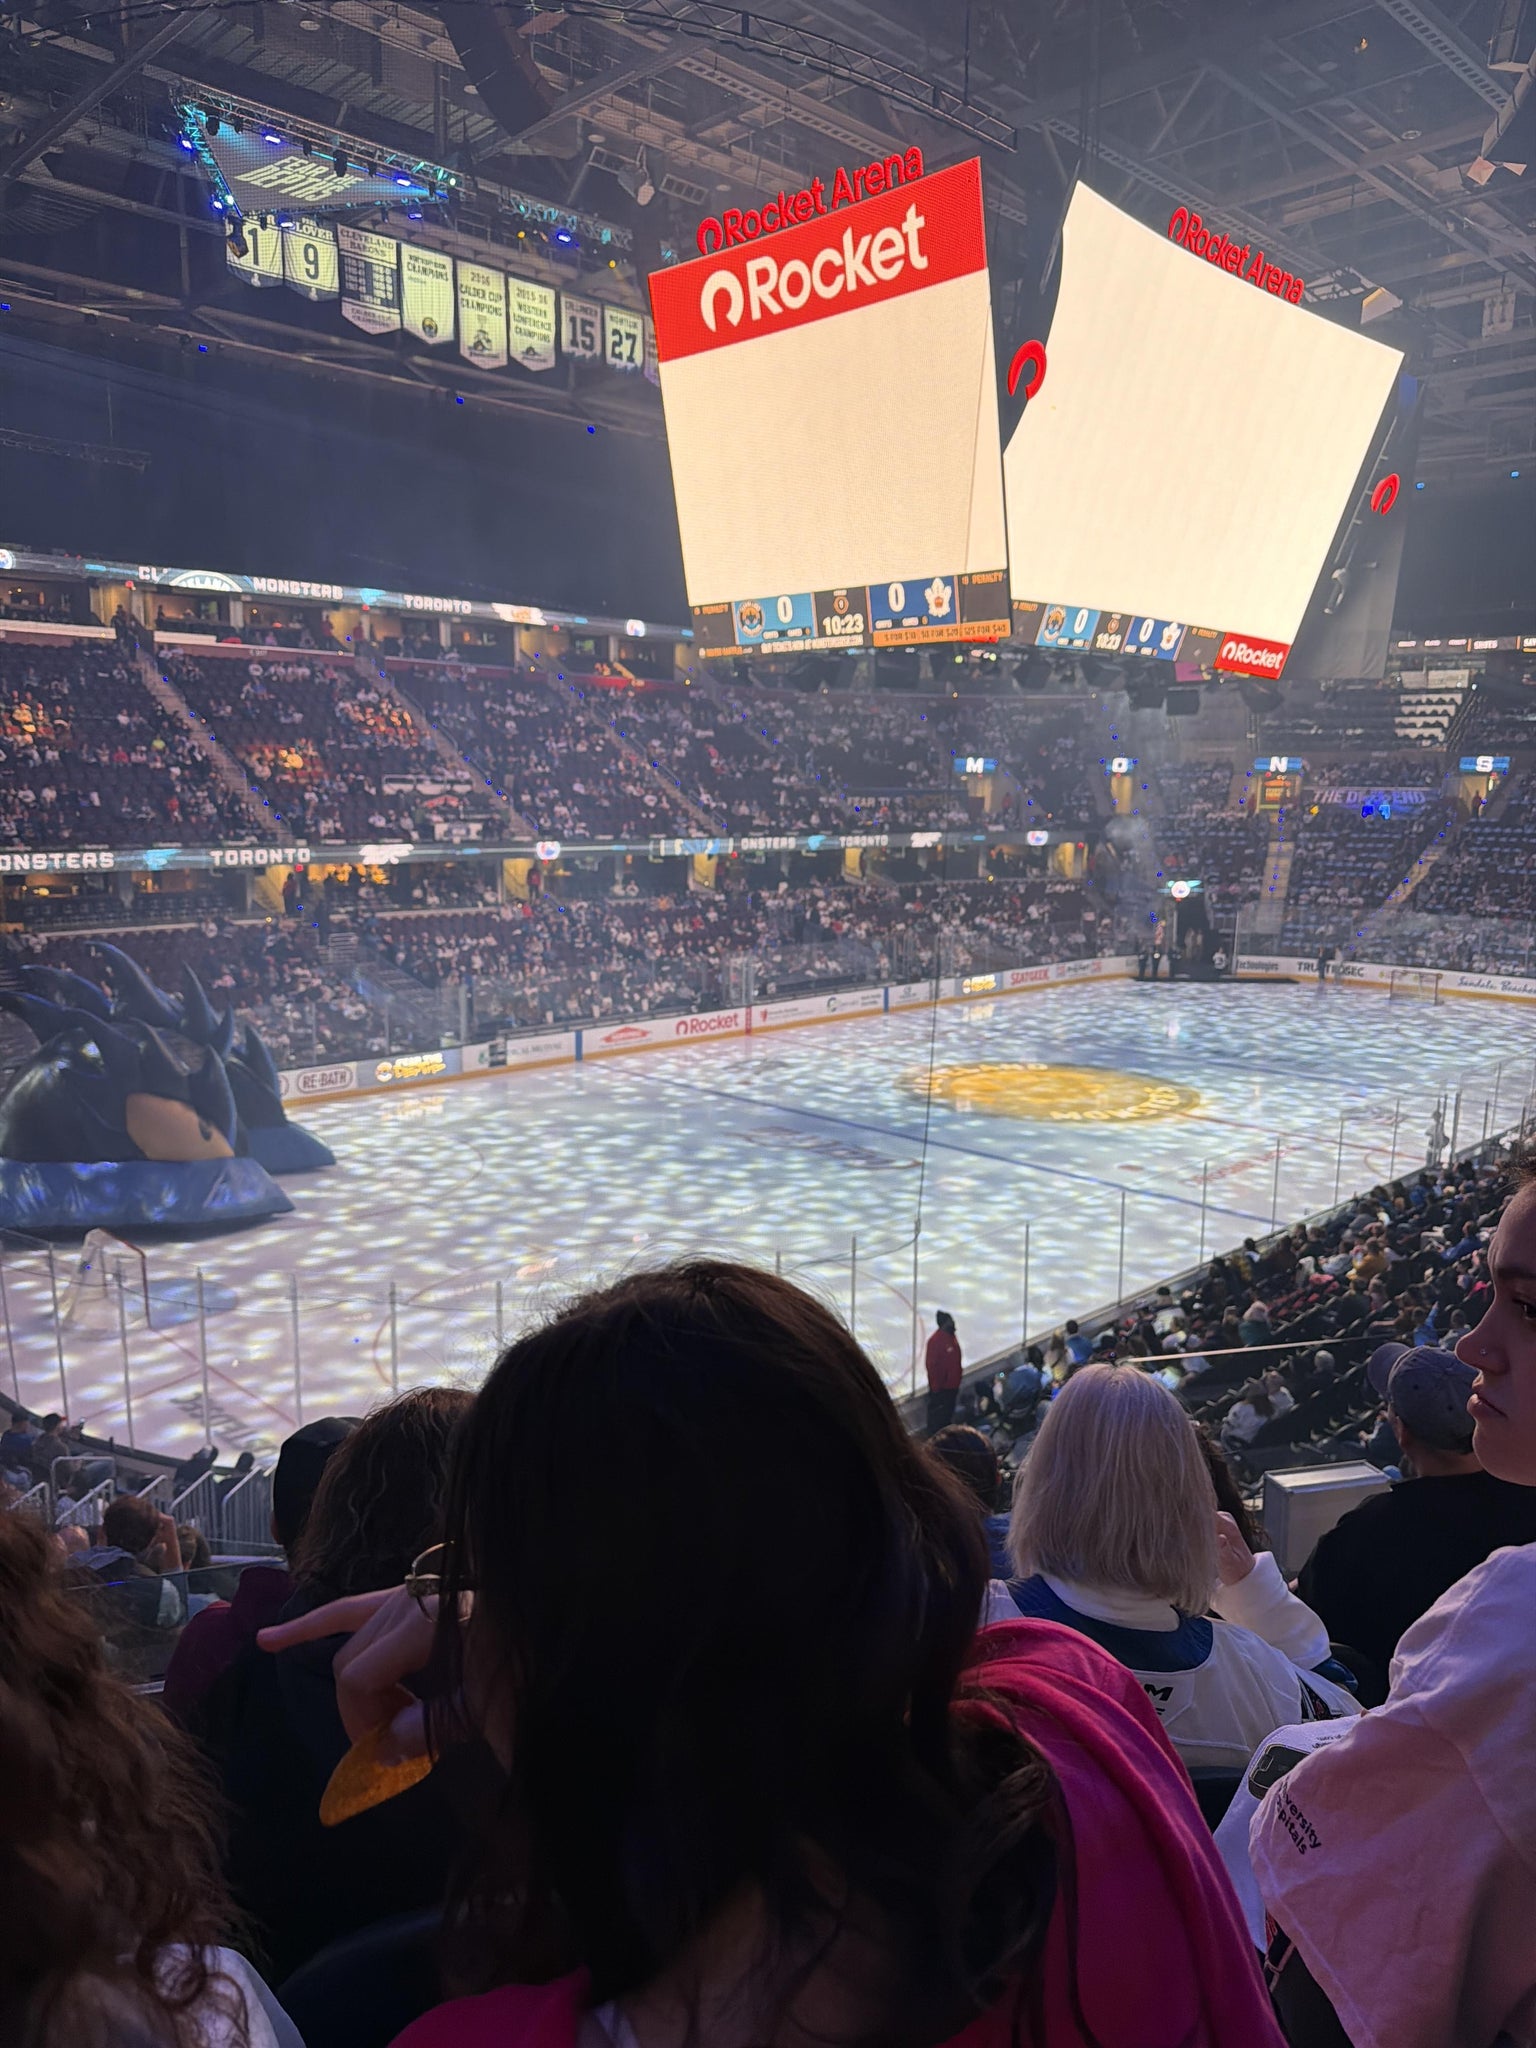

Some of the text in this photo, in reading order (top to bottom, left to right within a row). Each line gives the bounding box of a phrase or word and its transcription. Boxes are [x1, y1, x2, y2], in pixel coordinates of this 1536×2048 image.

[274, 156, 329, 177] FEAR
[235, 164, 346, 202] DEPTHS
[723, 146, 924, 247] Rocket Arena
[294, 221, 333, 241] LOVER
[248, 227, 259, 266] 1
[1183, 212, 1305, 304] Rocket Arena
[303, 242, 319, 280] 9
[745, 202, 929, 321] Rocket
[569, 315, 595, 352] 15
[611, 328, 637, 363] 27
[252, 576, 343, 600] MONSTERS
[888, 582, 905, 612] 0
[404, 594, 472, 614] TORONTO
[777, 595, 793, 624] 0
[822, 612, 864, 637] 10:23
[1073, 608, 1089, 634] 0
[1139, 618, 1155, 643] 0
[1234, 645, 1284, 670] Rocket
[965, 755, 1494, 773] M O N S
[1313, 790, 1343, 804] THE
[839, 835, 889, 848] TORONTO
[208, 848, 311, 866] TORONTO
[689, 1013, 738, 1034] Rocket
